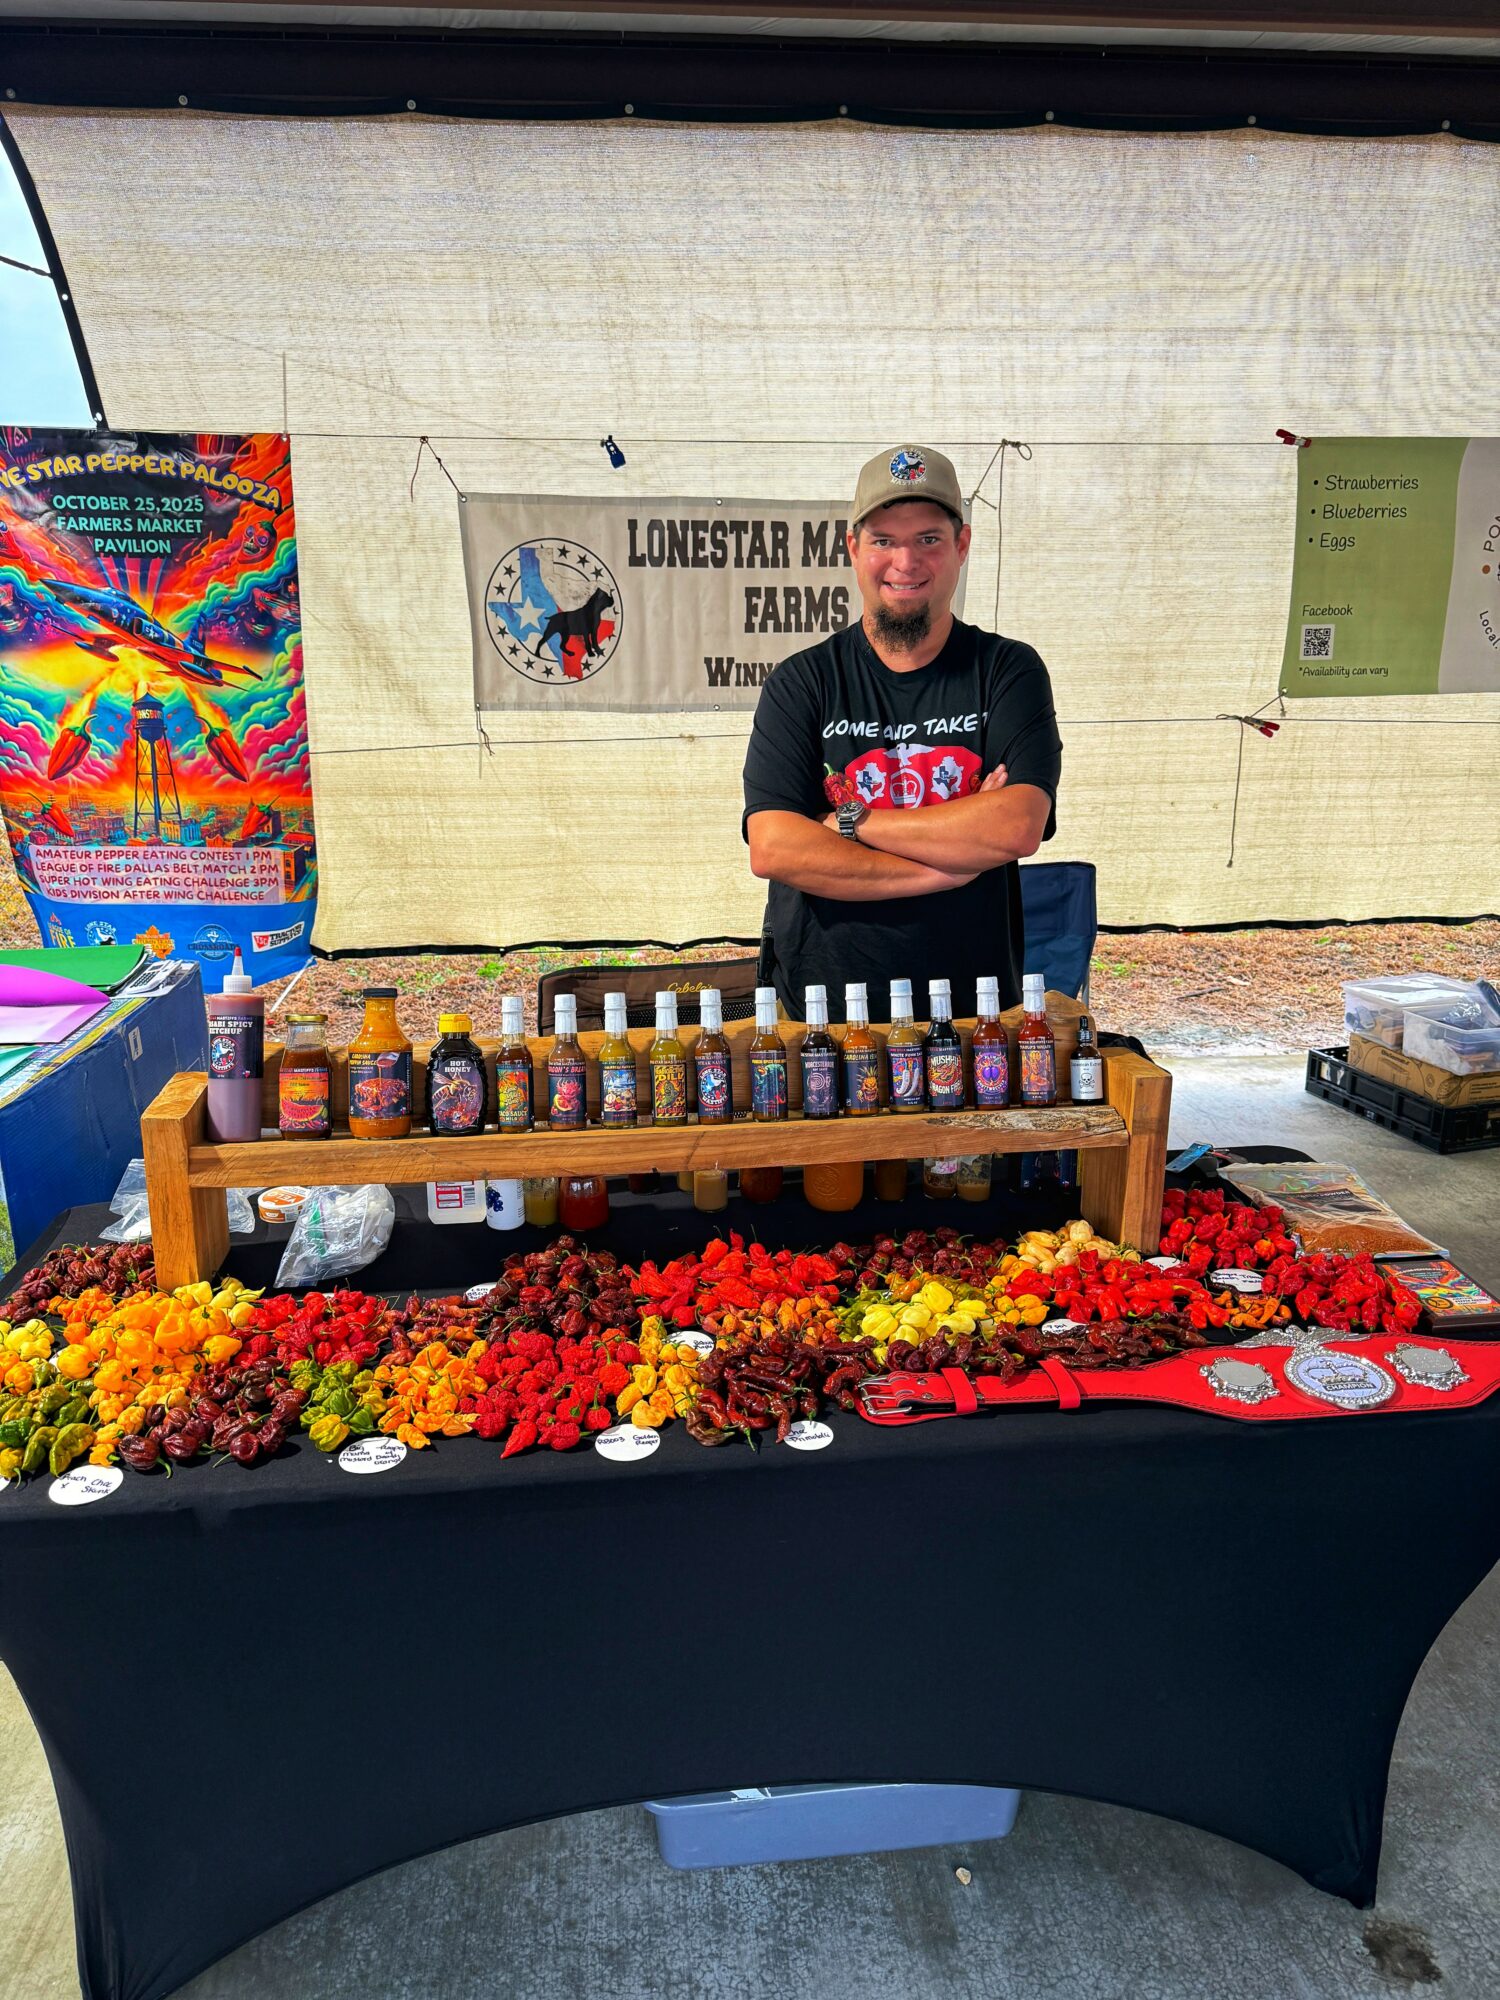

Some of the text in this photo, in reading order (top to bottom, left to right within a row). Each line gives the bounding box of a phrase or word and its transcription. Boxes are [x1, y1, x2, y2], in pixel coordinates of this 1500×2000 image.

[26, 456, 84, 481] STAR
[86, 453, 176, 476] PEPPER
[180, 462, 280, 508] PALOOZA
[1324, 474, 1419, 491] Strawberries
[52, 495, 204, 513] OCTOBER 25,2025
[1322, 503, 1408, 519] Blueberries
[57, 516, 203, 533] FARMERS MARKET
[94, 538, 171, 554] PAVILION
[628, 518, 790, 568] LONESTAR
[1320, 532, 1356, 552] Eggs
[744, 586, 850, 633] FARMS
[1302, 604, 1353, 616] Facebook
[704, 656, 781, 687] WINN
[1352, 667, 1368, 675] can
[1369, 667, 1389, 677] vary
[822, 719, 879, 739] COME
[883, 723, 917, 741] AND
[923, 713, 978, 736] TAKE
[35, 849, 92, 860] AMATEUR
[95, 850, 139, 860] PEPPER
[143, 850, 187, 860] EATING
[190, 850, 242, 860] CONTEST
[253, 850, 272, 860] PM
[35, 862, 279, 874] LEAGUE OF FIRE DALLAS BELT MATCH 2 PM
[39, 875, 279, 887] SUPER HOT WING EATING CHALLENGE 3PM
[46, 888, 265, 900] KIDS DIVISION AFTER WING CHALLENGE
[49, 929, 76, 948] FIRE
[187, 943, 240, 951] CROSSROAD
[667, 981, 713, 993] Cabela's
[658, 1073, 684, 1081] DILL
[1325, 1382, 1375, 1391] CHAMPION
